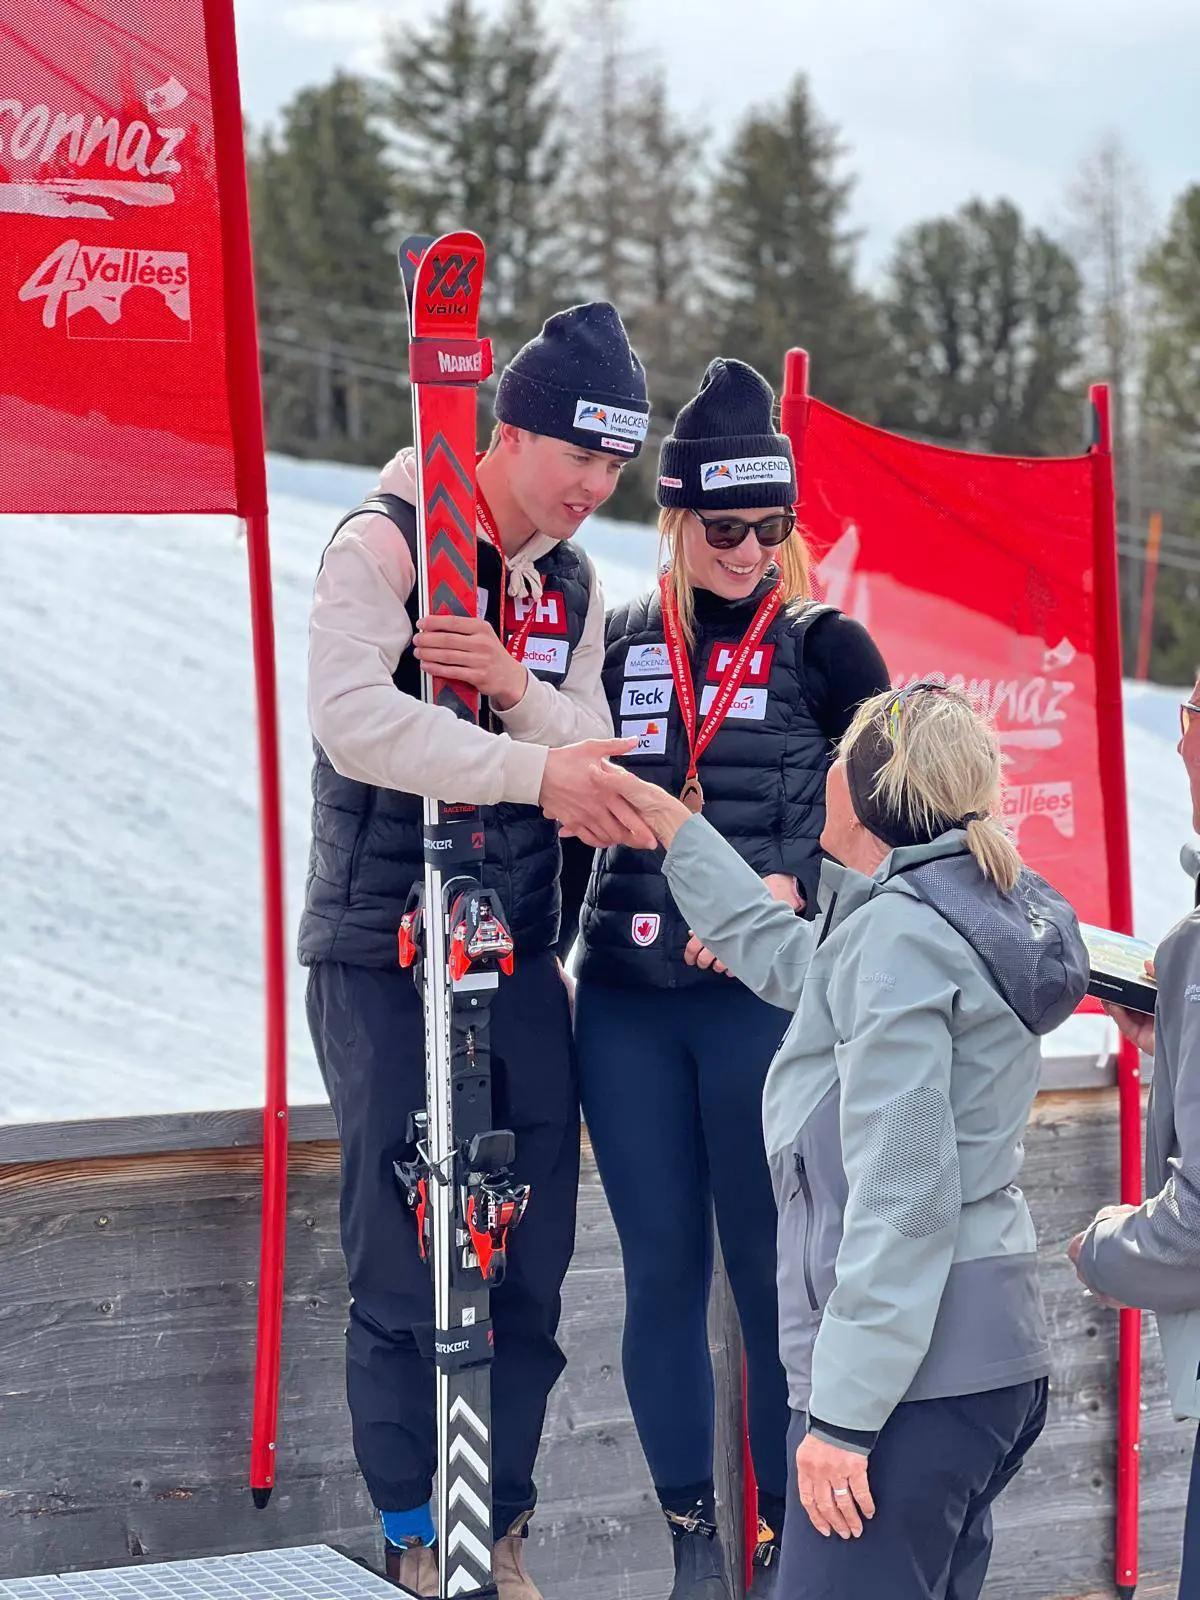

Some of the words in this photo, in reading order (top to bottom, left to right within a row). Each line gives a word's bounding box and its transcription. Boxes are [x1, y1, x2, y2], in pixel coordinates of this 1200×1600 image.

[18, 238, 83, 328] 4
[81, 251, 188, 286] Vallées
[736, 473, 773, 481] Investments
[523, 651, 552, 663] edtag
[630, 659, 670, 668] MACKENZIE
[628, 687, 664, 706] Teck
[705, 714, 718, 734] PARA
[714, 690, 730, 716] ALPINE
[726, 678, 735, 692] SKI
[731, 644, 751, 680] WORLDCUP
[1002, 786, 1071, 815] allées
[443, 805, 476, 814] RACETIGER
